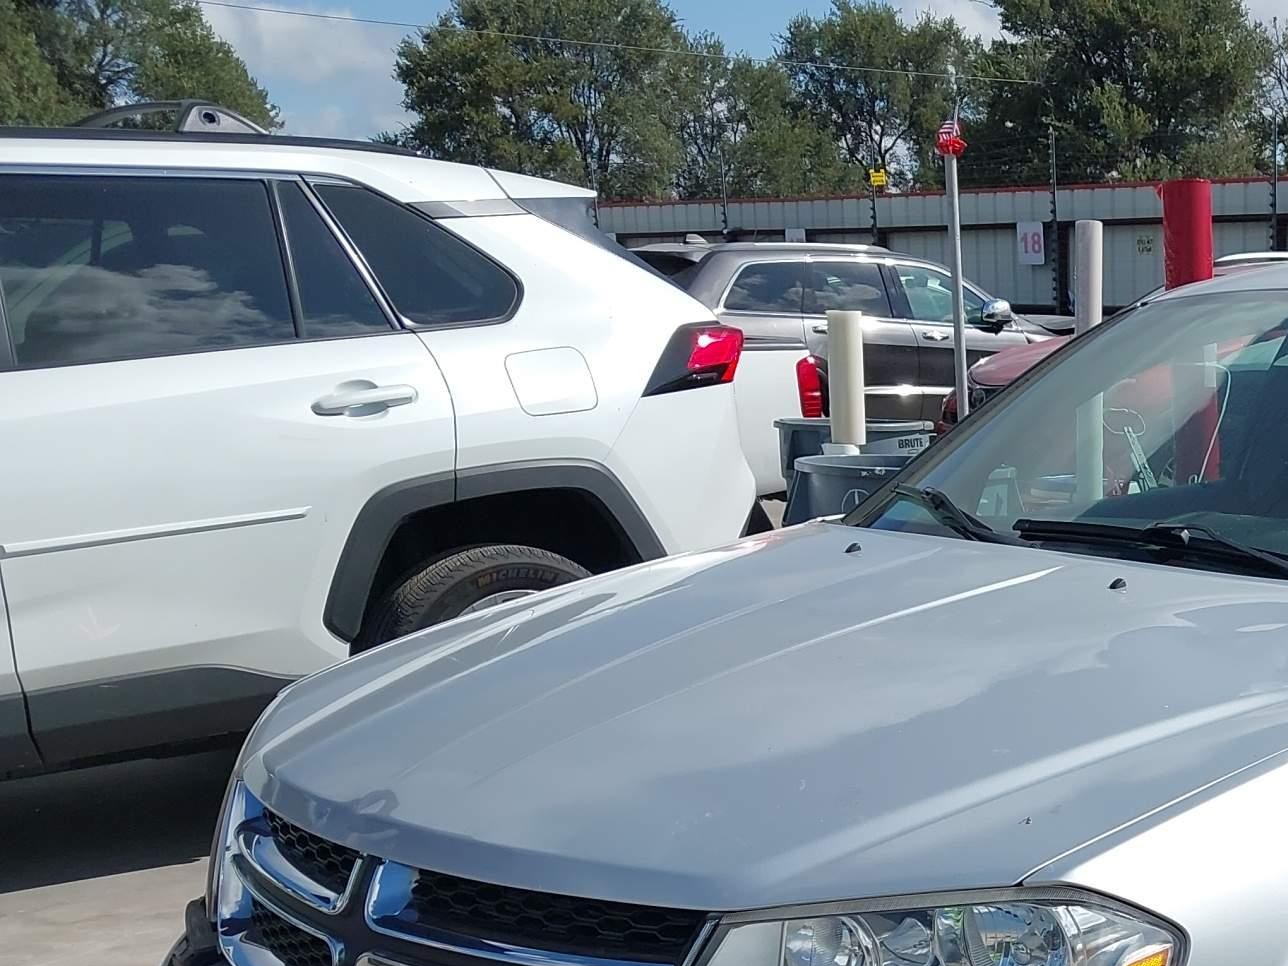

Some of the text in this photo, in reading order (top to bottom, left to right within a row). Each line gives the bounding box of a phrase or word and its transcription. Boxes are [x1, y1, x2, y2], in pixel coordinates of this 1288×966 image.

[1020, 232, 1042, 254] 18
[898, 438, 924, 449] BRUTE
[476, 567, 558, 589] MICHELIN
